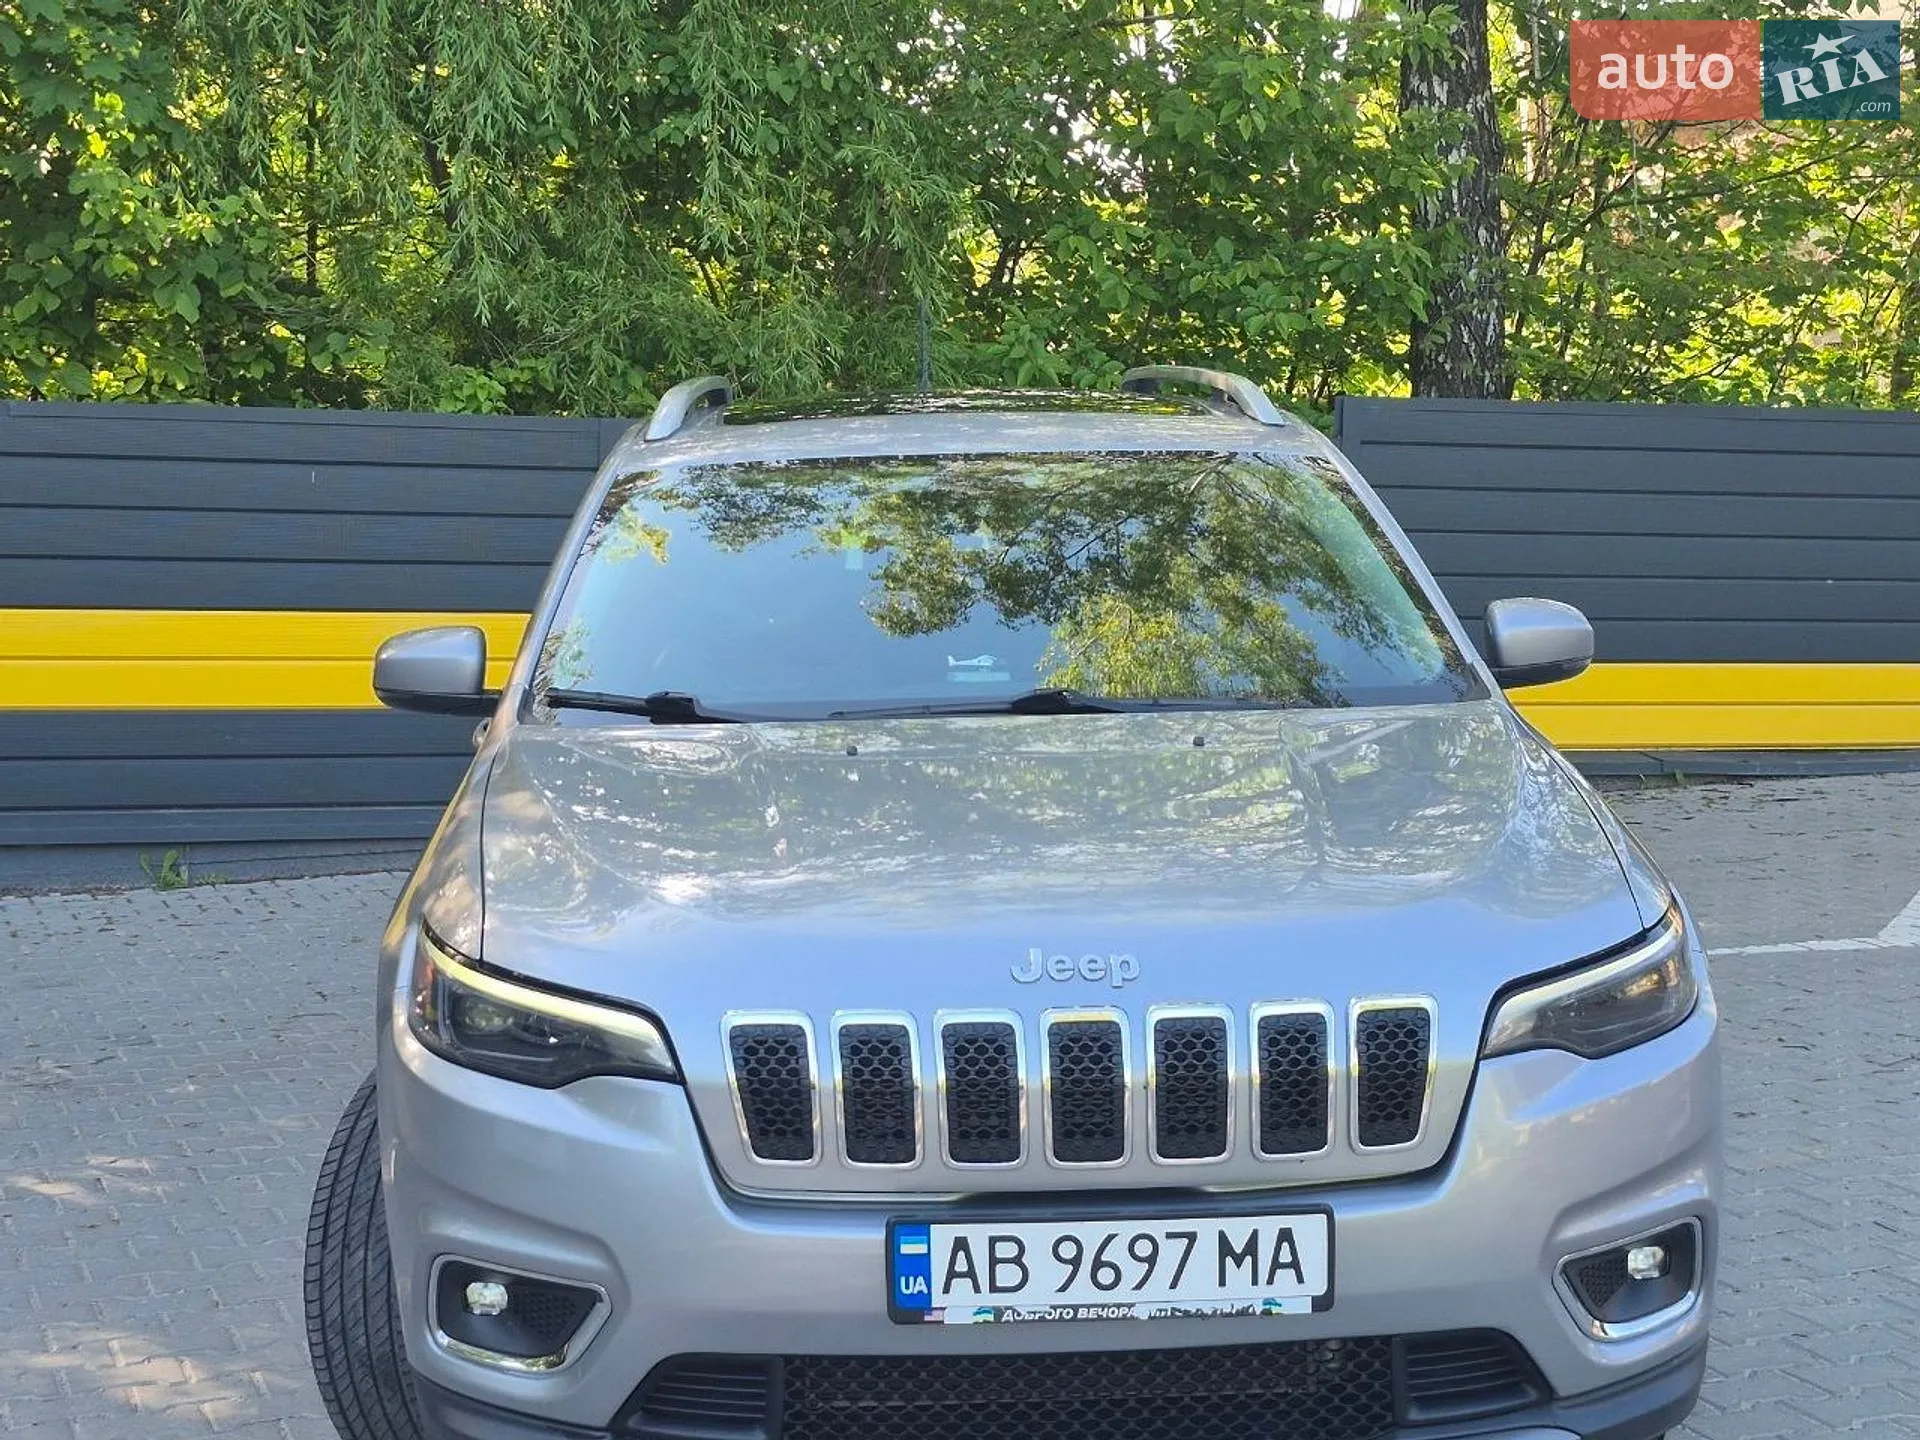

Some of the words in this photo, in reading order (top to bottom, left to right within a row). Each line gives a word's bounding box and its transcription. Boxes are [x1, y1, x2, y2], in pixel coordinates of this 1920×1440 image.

[1010, 947, 1142, 989] Jeep
[942, 1234, 1030, 1294] AB
[1051, 1231, 1198, 1293] 9697
[1217, 1227, 1306, 1287] MA
[900, 1275, 929, 1295] UA
